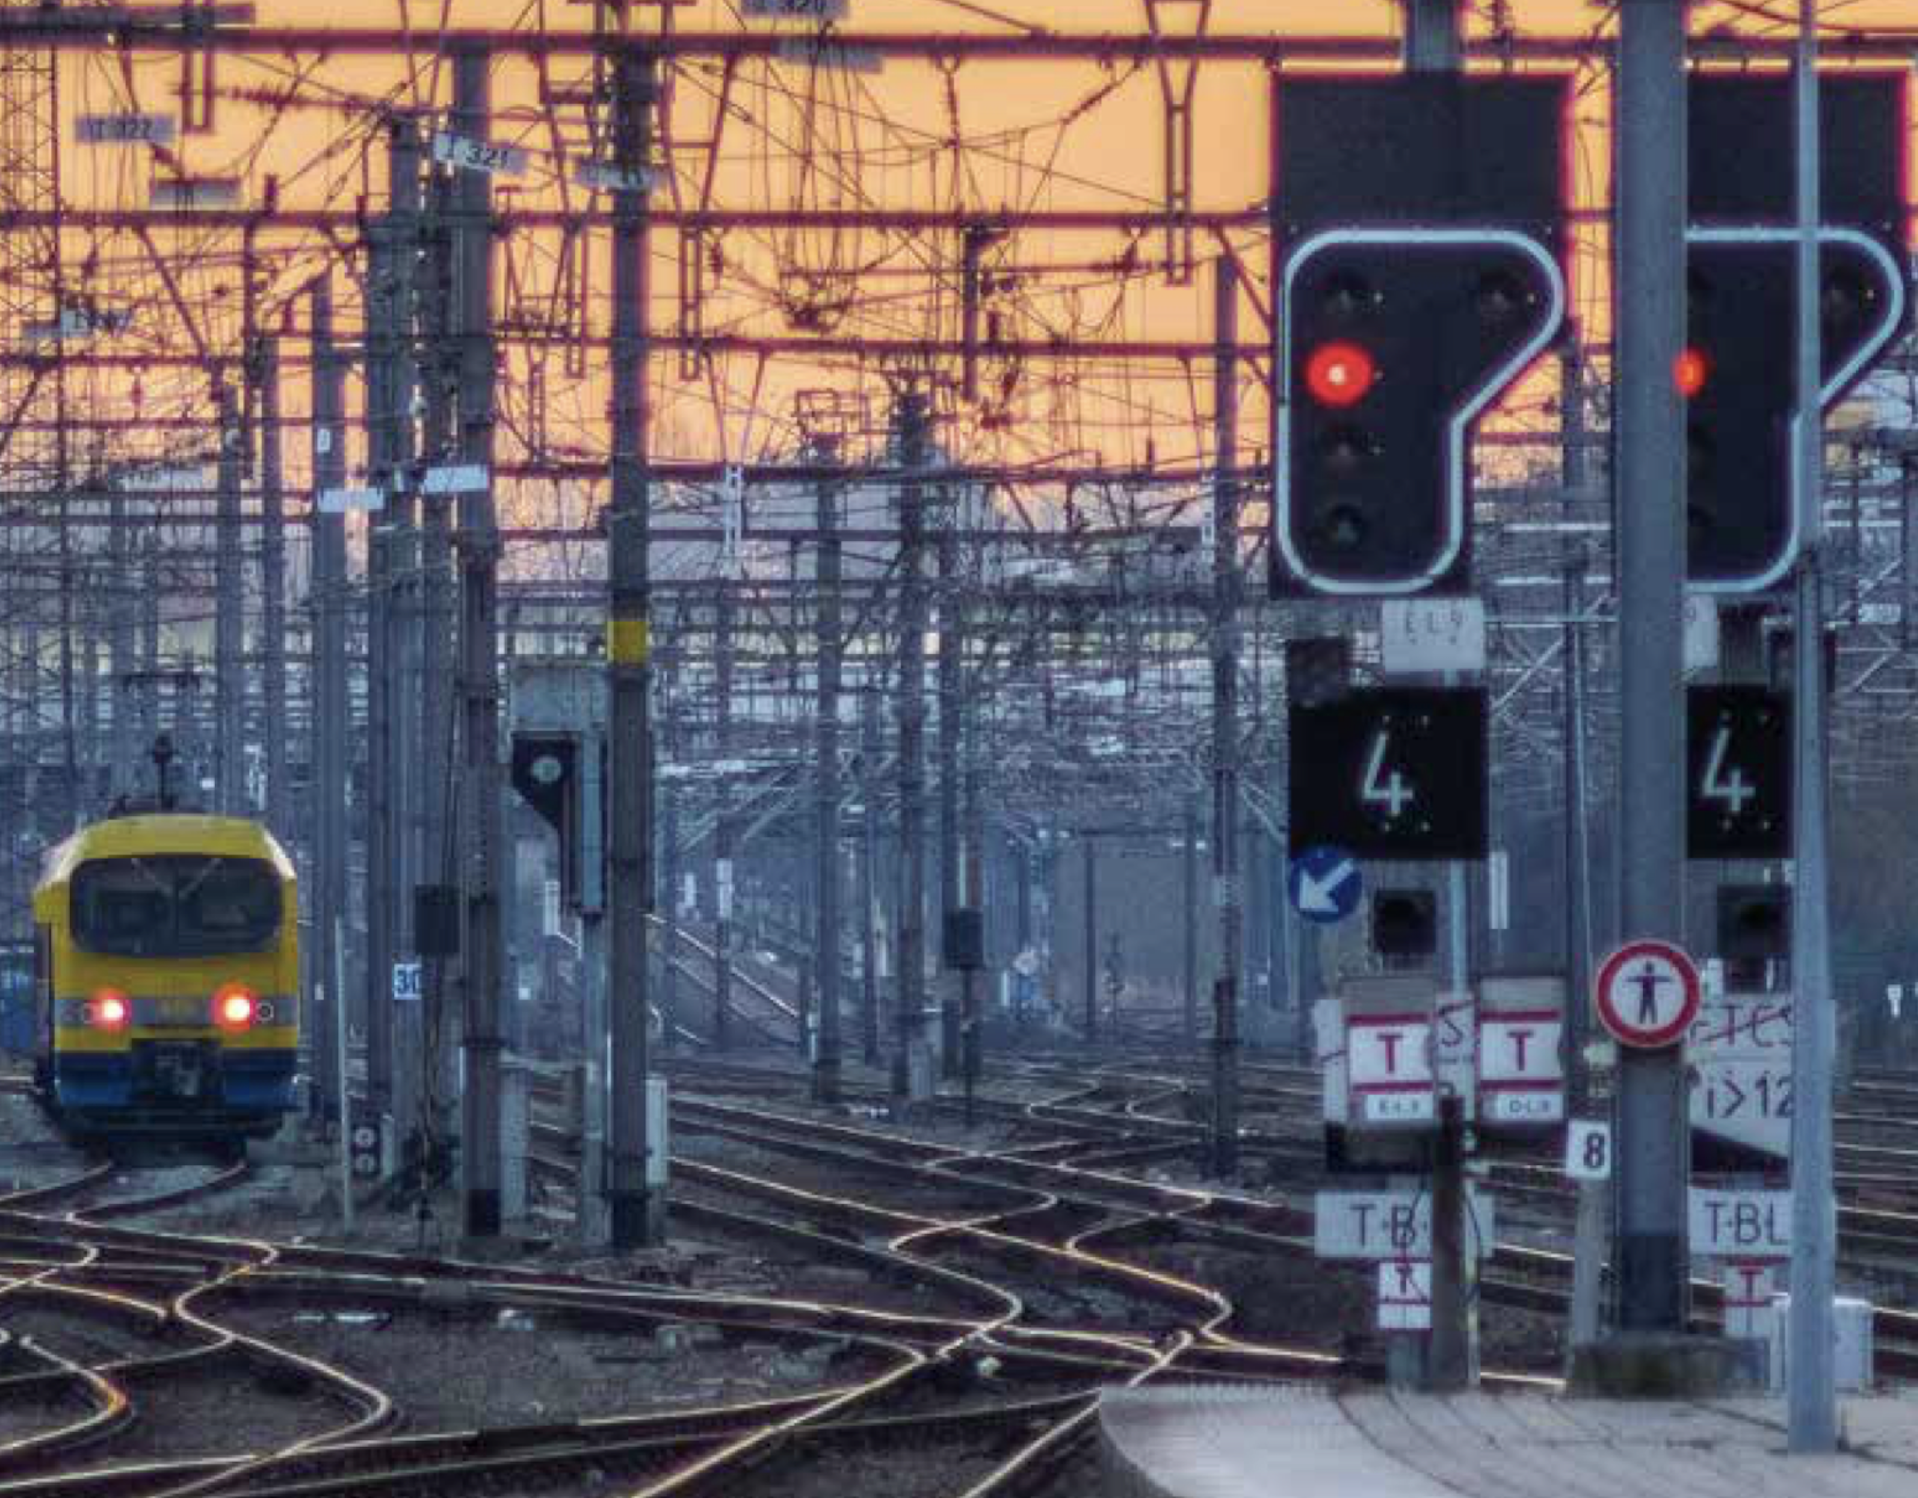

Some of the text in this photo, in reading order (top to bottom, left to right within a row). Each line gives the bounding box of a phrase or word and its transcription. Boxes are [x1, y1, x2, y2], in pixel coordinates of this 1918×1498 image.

[1361, 731, 1414, 816] 4
[1703, 727, 1756, 812] 4
[1377, 1033, 1403, 1073] T
[1507, 1030, 1534, 1072] T
[1583, 1132, 1605, 1169] 8
